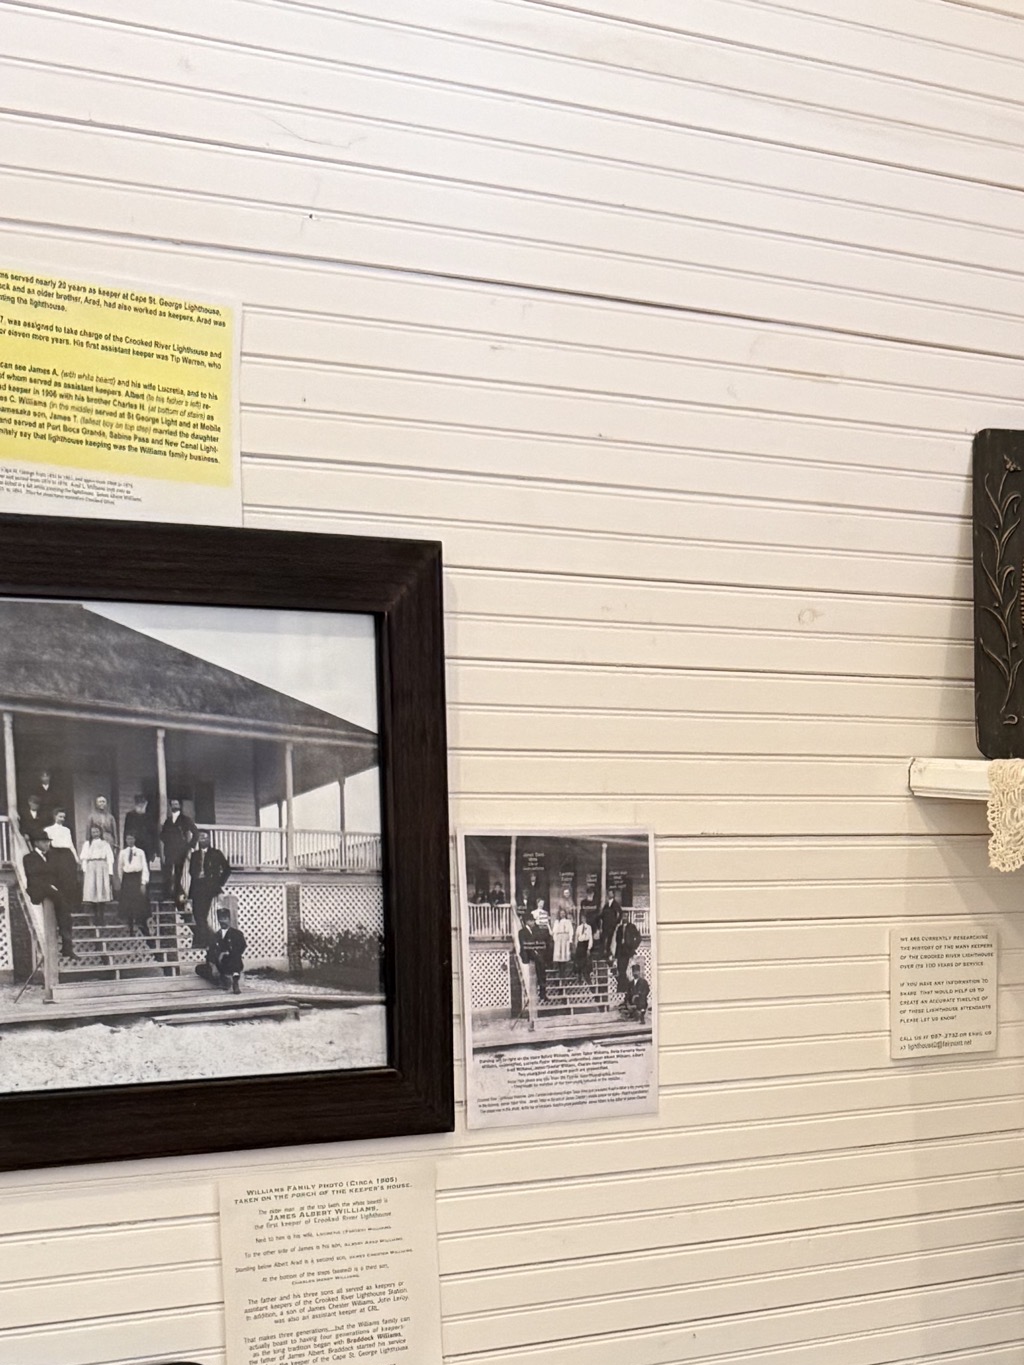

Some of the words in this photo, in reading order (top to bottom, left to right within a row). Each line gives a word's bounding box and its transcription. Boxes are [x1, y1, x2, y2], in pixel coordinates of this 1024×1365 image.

[9, 273, 34, 284] served
[34, 277, 56, 289] nearly
[57, 279, 66, 289] 20
[67, 283, 87, 293] years
[87, 286, 96, 294] as
[97, 287, 121, 299] keeper
[121, 292, 128, 300] at
[129, 292, 146, 303] Cape
[147, 295, 156, 305] St.
[158, 297, 182, 310] George
[245, 1186, 284, 1196] WILLIAMS
[286, 1183, 316, 1192] FAMILY
[233, 1196, 258, 1204] TAKEN
[268, 1212, 296, 1221] JAMES
[298, 1209, 331, 1218] ALBERT
